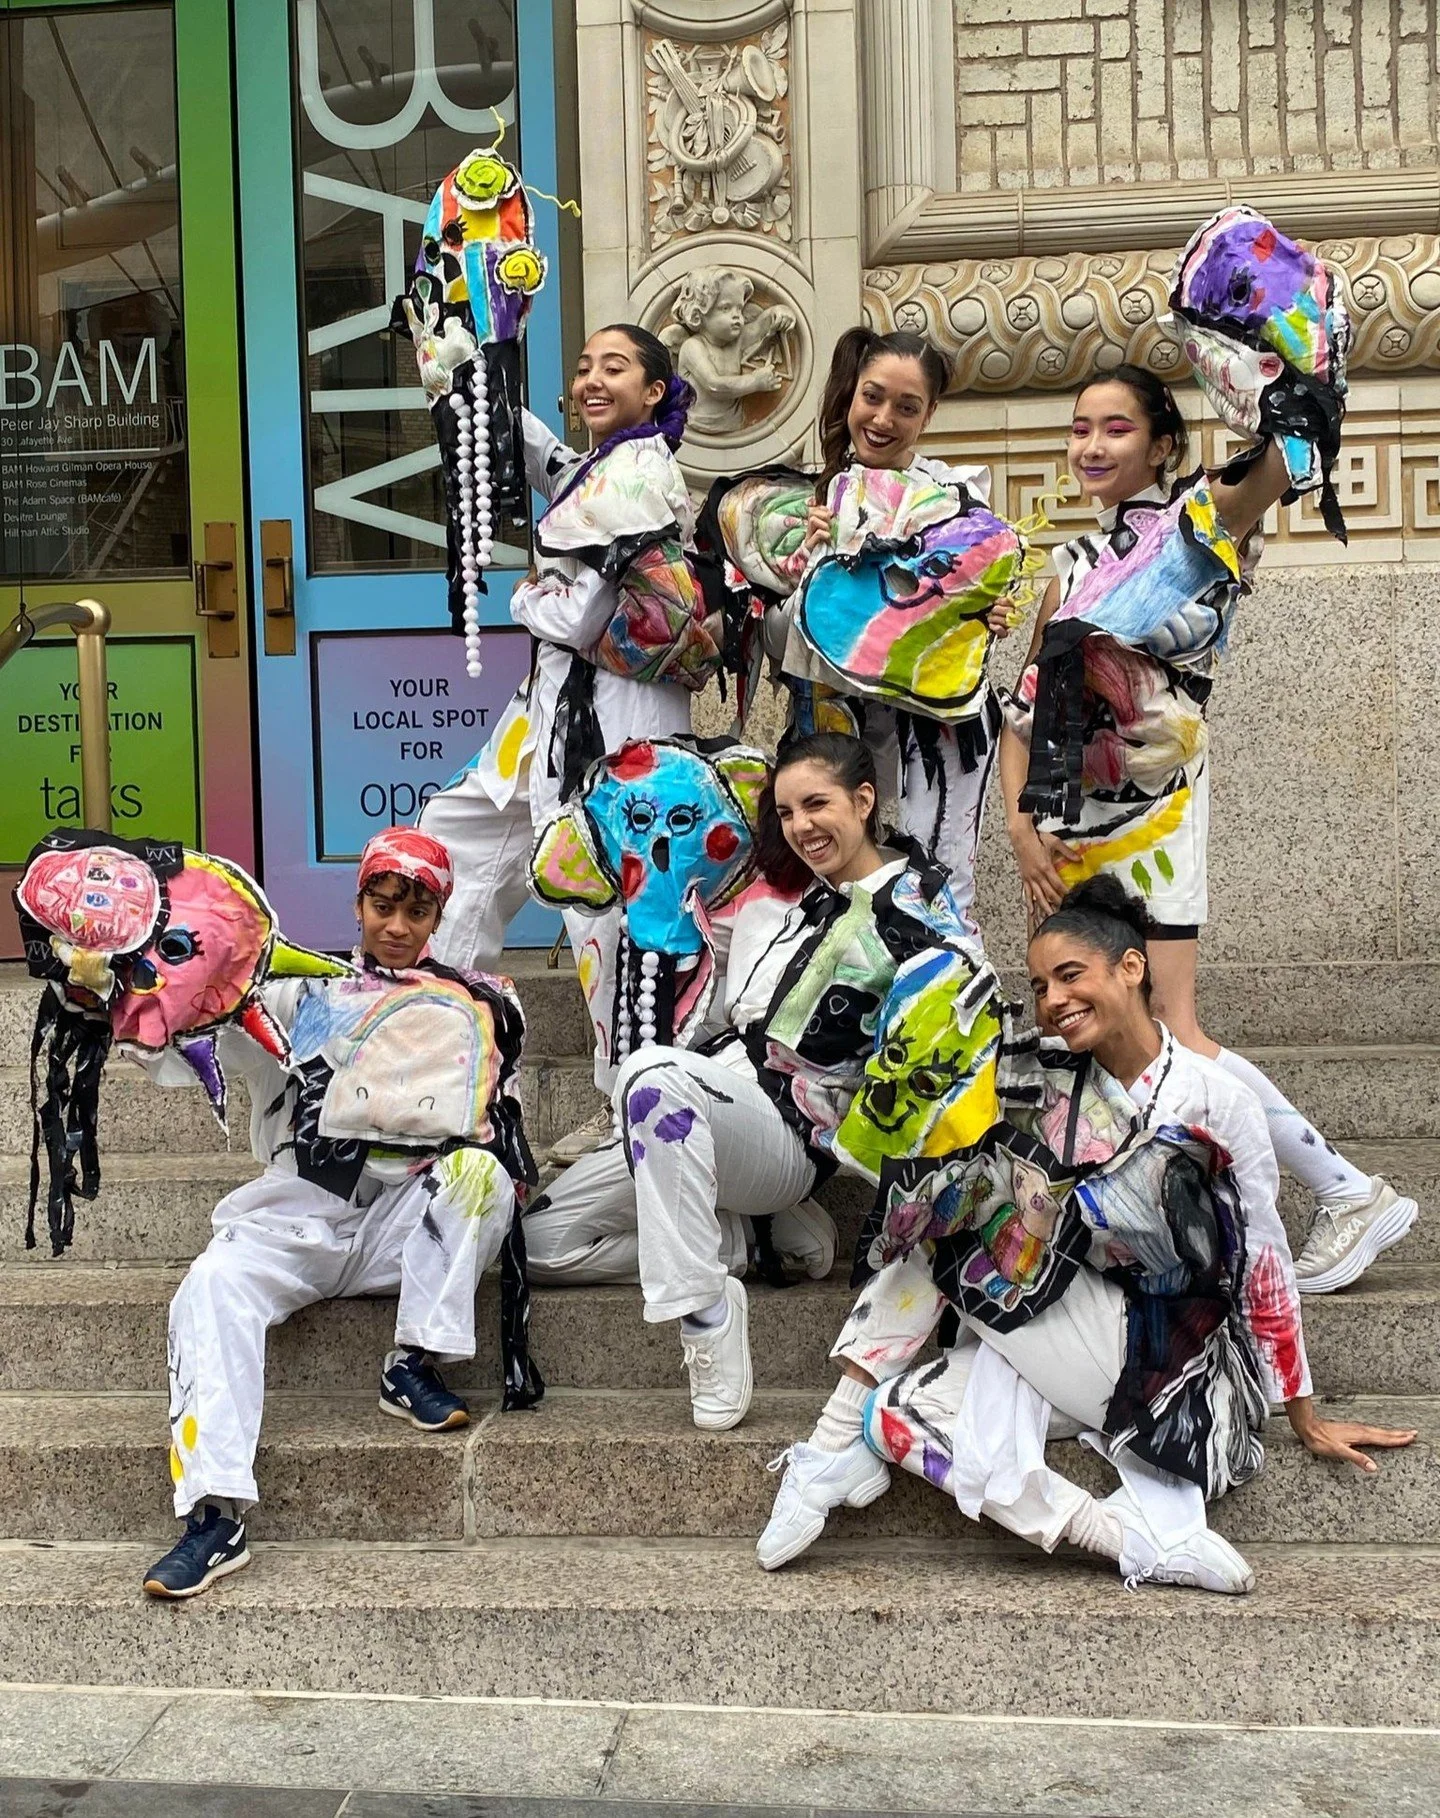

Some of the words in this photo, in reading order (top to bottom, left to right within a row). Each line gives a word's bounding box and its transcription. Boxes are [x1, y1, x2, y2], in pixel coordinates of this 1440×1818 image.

[0, 337, 159, 410] BAM
[0, 417, 34, 431] Peter
[38, 416, 60, 432] Jay
[64, 414, 103, 431] Sharp
[107, 413, 160, 429] Building
[1, 436, 13, 447] 30
[18, 434, 54, 447] afayette
[57, 435, 73, 445] Ave
[1, 464, 22, 475] BAM
[25, 463, 59, 474] Howard
[62, 461, 93, 473] Gilman
[96, 461, 122, 473] Opera
[124, 460, 153, 471] House
[2, 479, 23, 490] BAM
[26, 479, 47, 489] Rose
[50, 478, 88, 488] Cinemas
[3, 496, 18, 507] The
[22, 495, 47, 506] Adam
[49, 494, 75, 507] Space
[36, 511, 68, 523] Lounge
[41, 526, 60, 537] Attic
[62, 525, 90, 536] Studio
[59, 681, 119, 701] YOR
[389, 678, 450, 698] YOUR
[17, 711, 163, 734] DESTITION
[353, 710, 423, 731] LOCAL
[432, 708, 489, 729] SPOT
[400, 741, 444, 761] FOR
[39, 776, 143, 820] tas
[1327, 1217, 1365, 1258] HOKA
